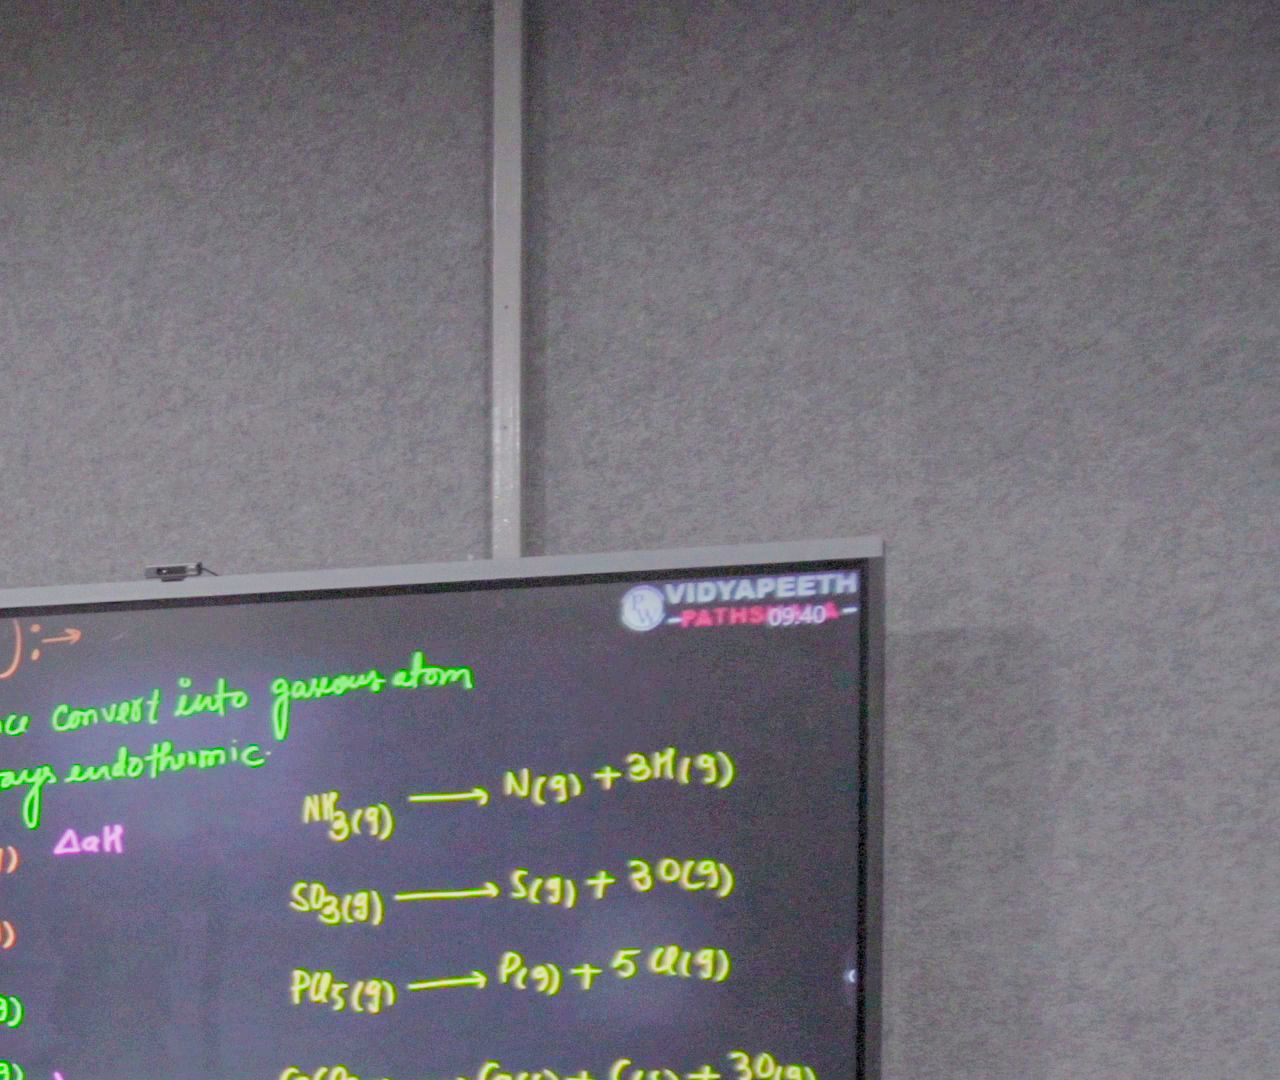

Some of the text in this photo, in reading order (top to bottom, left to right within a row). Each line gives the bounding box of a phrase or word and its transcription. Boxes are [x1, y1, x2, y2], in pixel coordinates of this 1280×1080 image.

[665, 573, 858, 604] VIDYAPEETH
[680, 601, 840, 628] PATHSA
[767, 605, 826, 627] 09:40
[174, 676, 248, 717] into
[392, 650, 475, 690] atom
